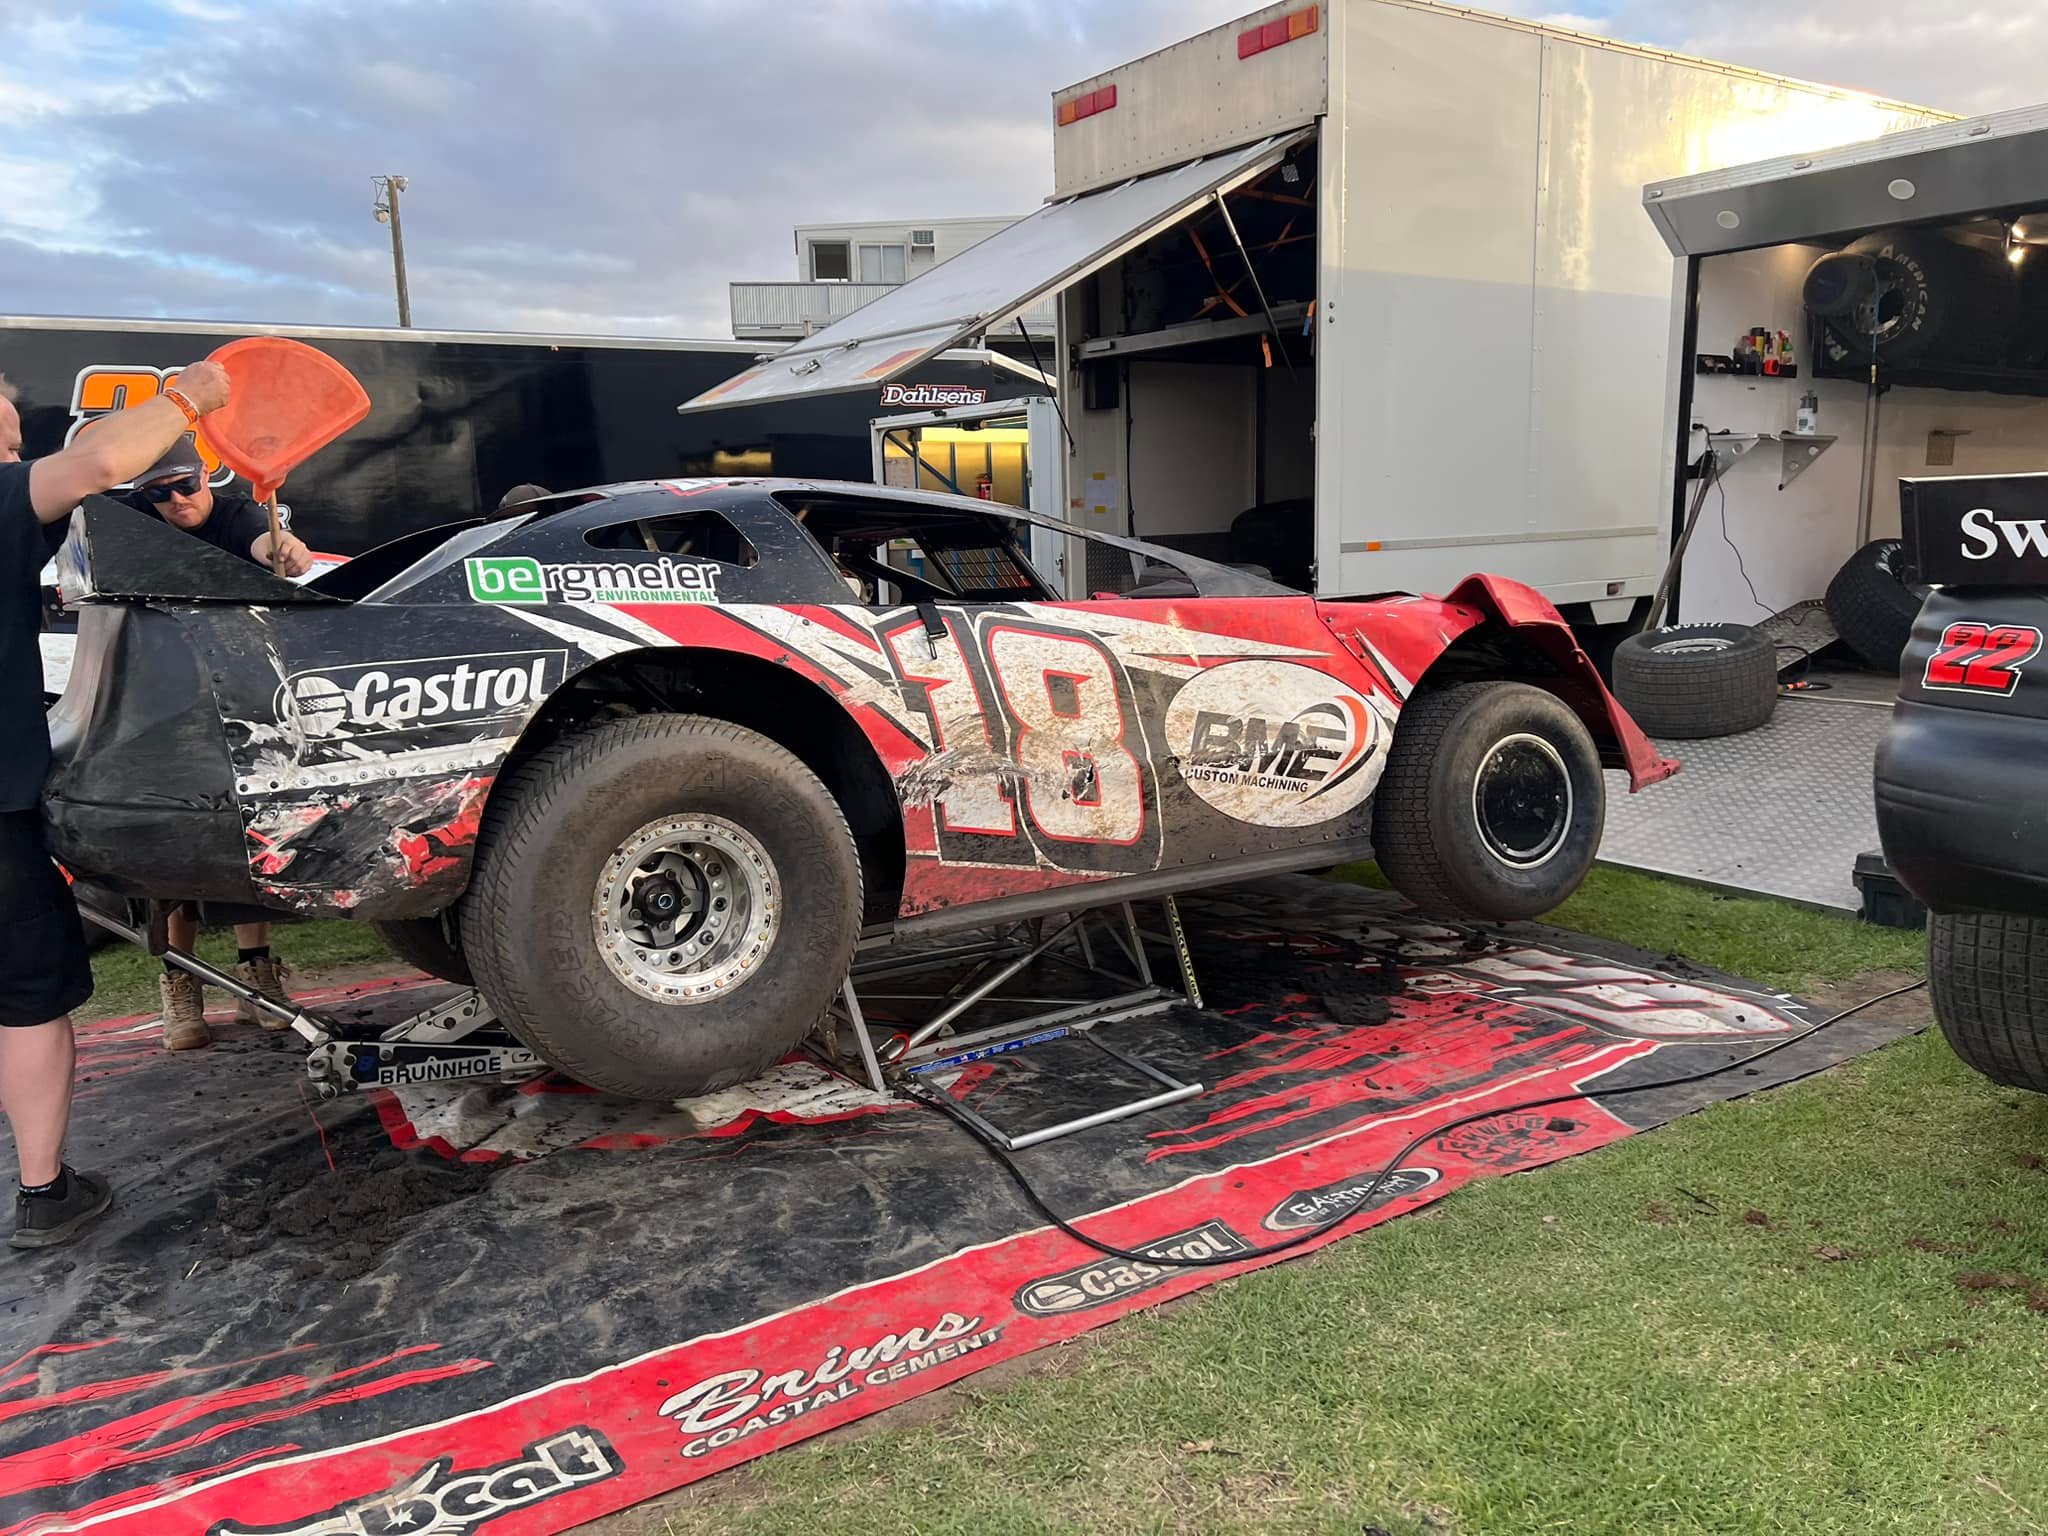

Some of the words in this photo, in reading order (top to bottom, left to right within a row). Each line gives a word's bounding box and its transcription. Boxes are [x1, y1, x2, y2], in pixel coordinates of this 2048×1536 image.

[883, 386, 983, 404] Dahlsens
[472, 557, 720, 601] bergmeier
[597, 590, 717, 602] ENVIRONMENTAL
[350, 657, 549, 726] Castrol
[1923, 623, 2041, 694] 22
[880, 612, 1152, 856] 18
[1190, 710, 1347, 782] BME
[1184, 767, 1239, 785] CUSTOM
[1241, 774, 1309, 794] MACHINING
[658, 1313, 984, 1434] Brims
[681, 1384, 859, 1457] COASTAL
[866, 1328, 1003, 1386] CEMENT
